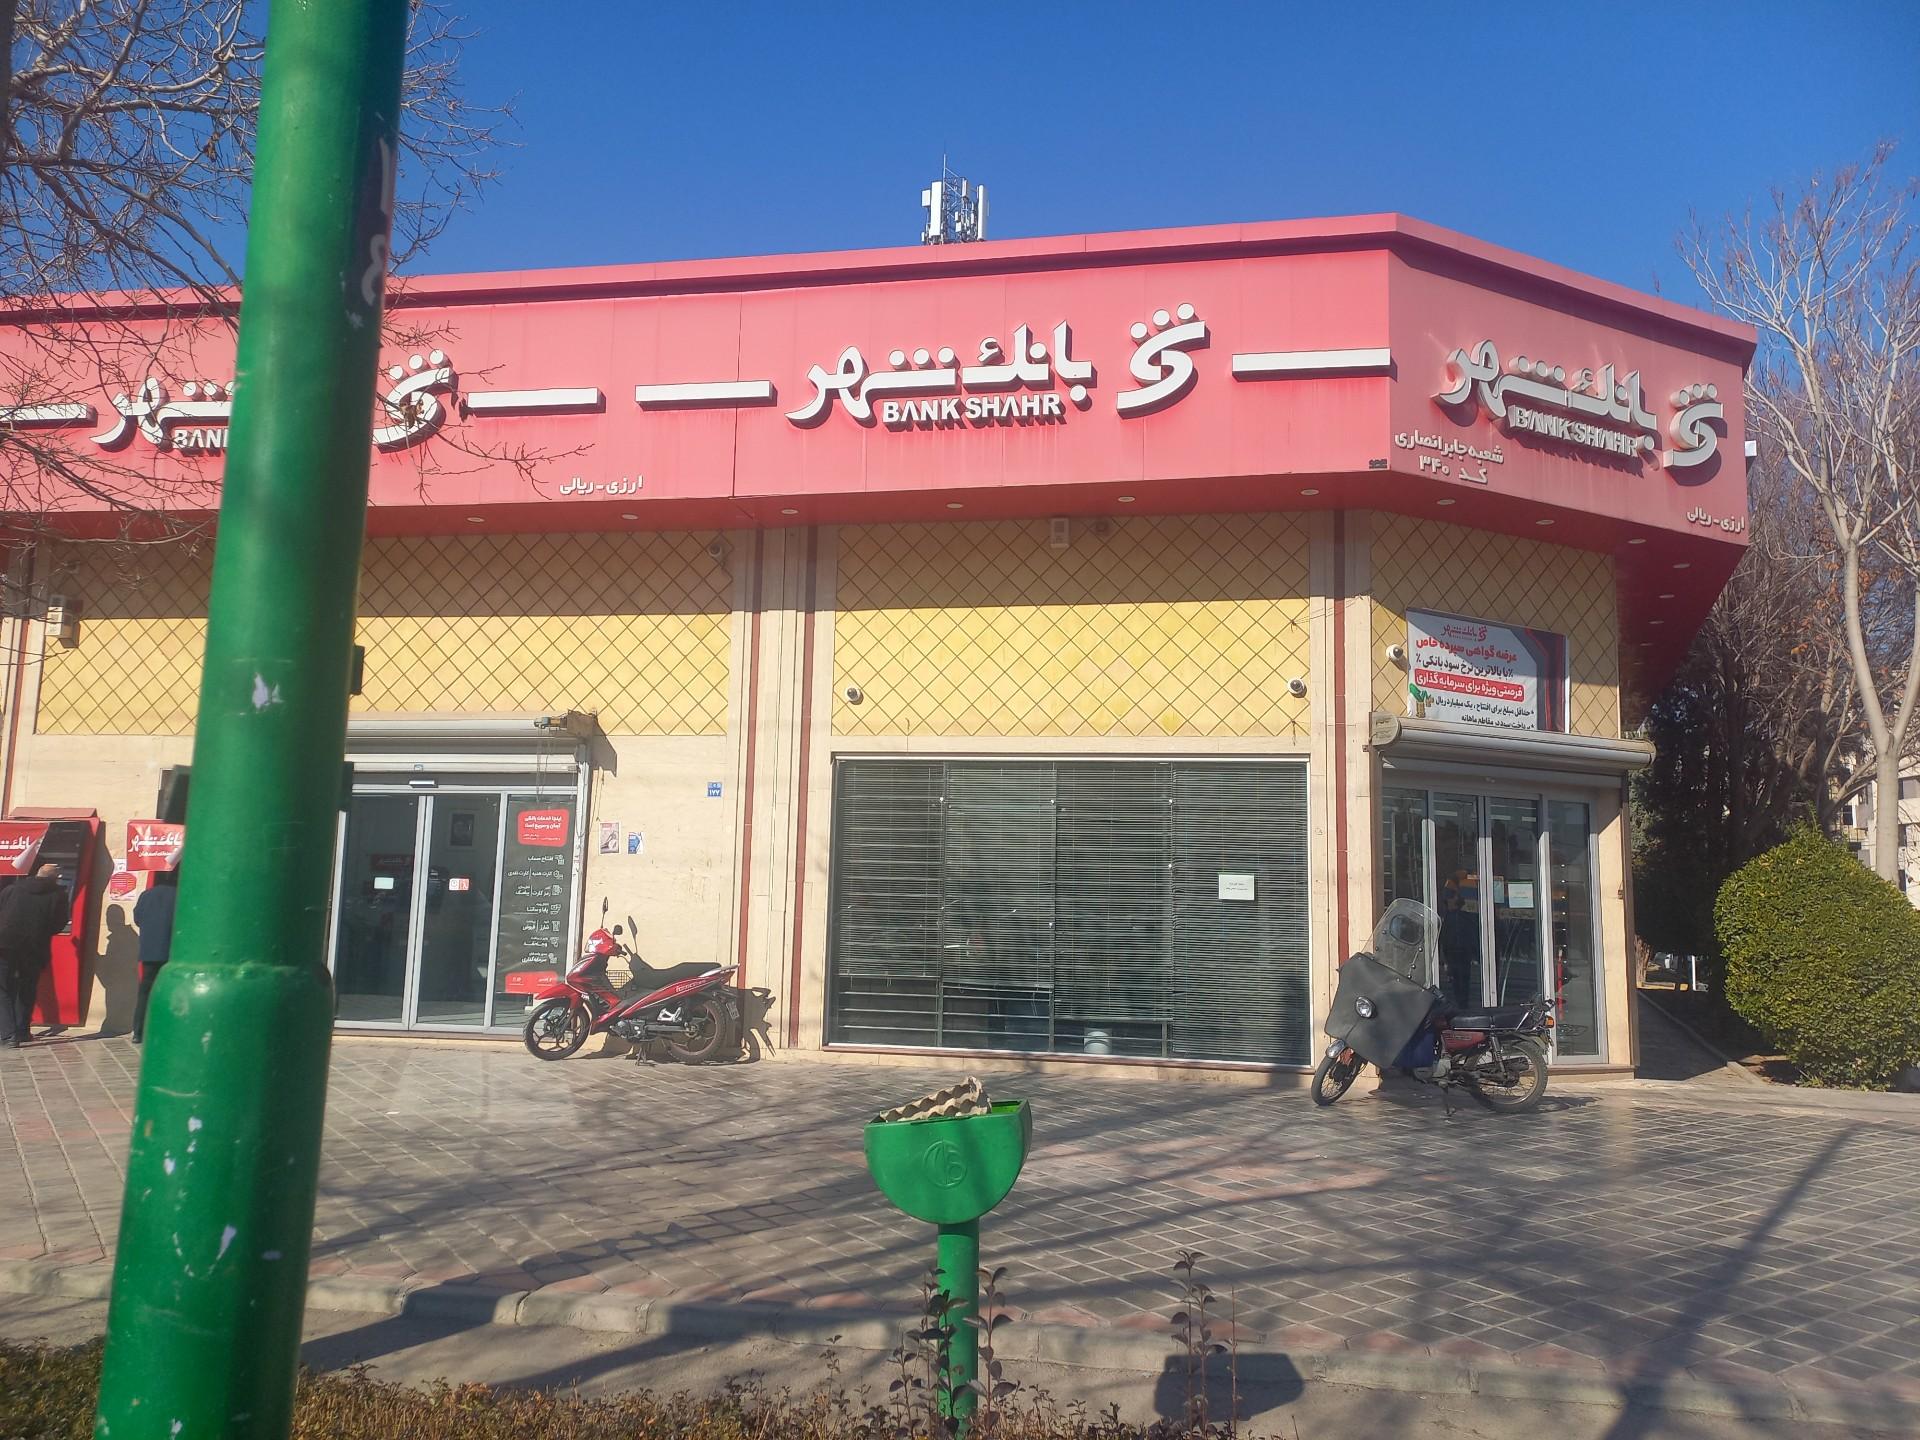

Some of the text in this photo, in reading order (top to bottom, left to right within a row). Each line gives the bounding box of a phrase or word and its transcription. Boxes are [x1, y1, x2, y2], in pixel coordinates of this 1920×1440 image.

[883, 393, 1062, 423] BANK SHAHR
[1395, 430, 1443, 450] انصاری
[1509, 405, 1640, 458] BANK SHAHR
[1468, 445, 1504, 465] شعبه
[1459, 467, 1488, 485] کد
